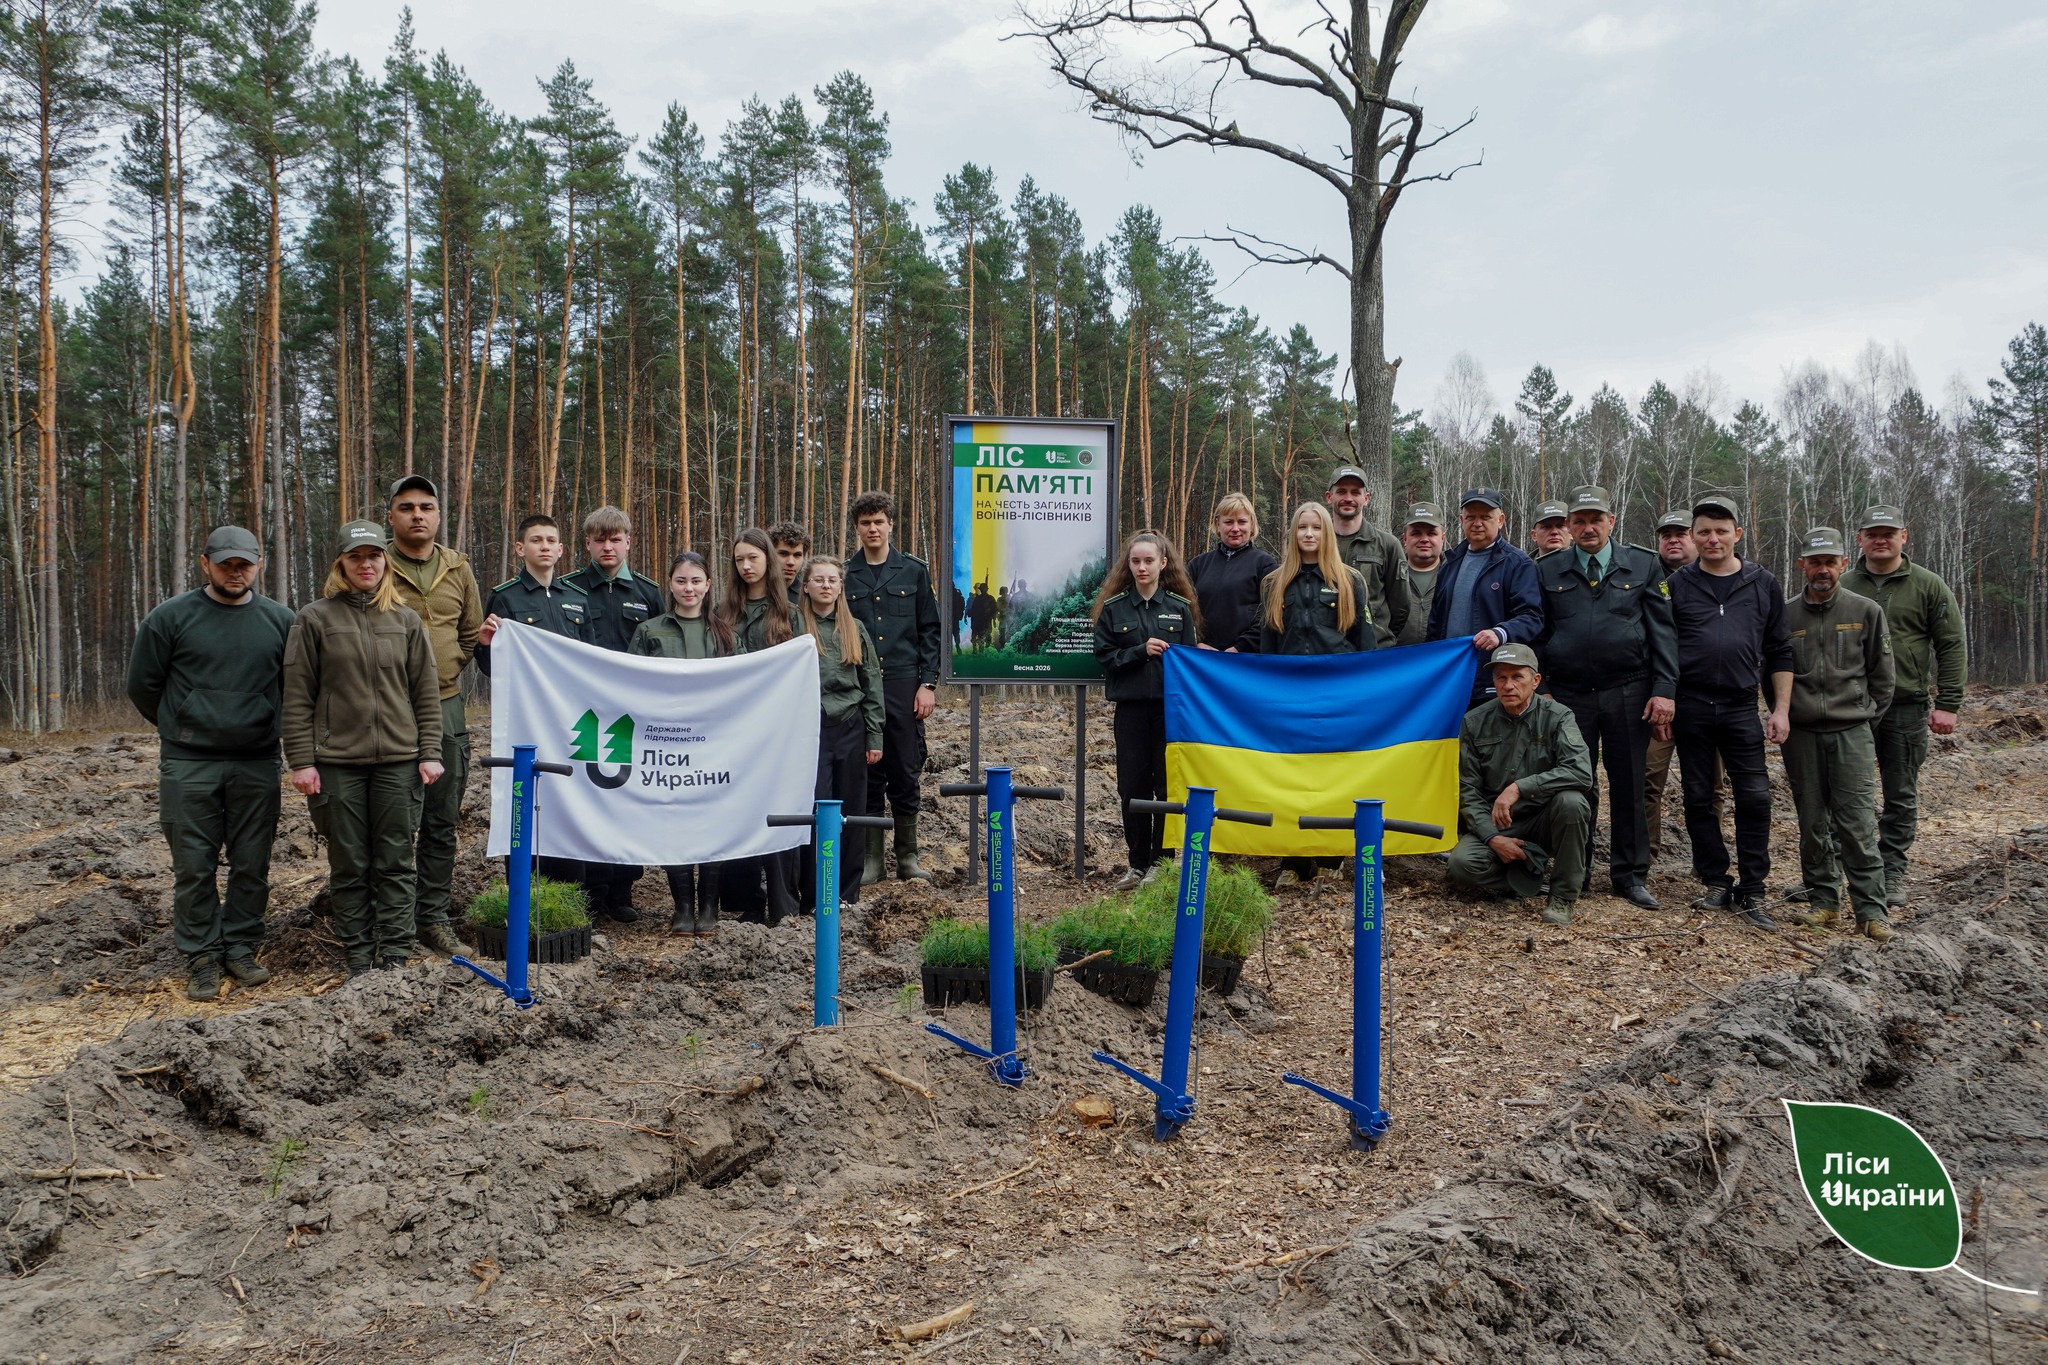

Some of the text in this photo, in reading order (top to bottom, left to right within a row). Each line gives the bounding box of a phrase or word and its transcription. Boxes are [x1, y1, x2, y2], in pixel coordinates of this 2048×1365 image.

[976, 445, 1025, 467] ЛІС
[976, 500, 1092, 510] НА ЧЕСТЬ ЗАГИБЛИХ
[976, 509, 1092, 521] ВОЇНІВ-ЛІСІВНИКІВ
[645, 724, 692, 734] Державне
[643, 734, 706, 743] підприємство
[640, 749, 690, 767] Ліси
[512, 840, 521, 848] 6
[992, 831, 1003, 892] SISUPUTKI 6
[1185, 852, 1202, 916] SISUPUTKI 6
[1363, 867, 1375, 931] SISUPUTKI 6
[823, 906, 833, 916] 6
